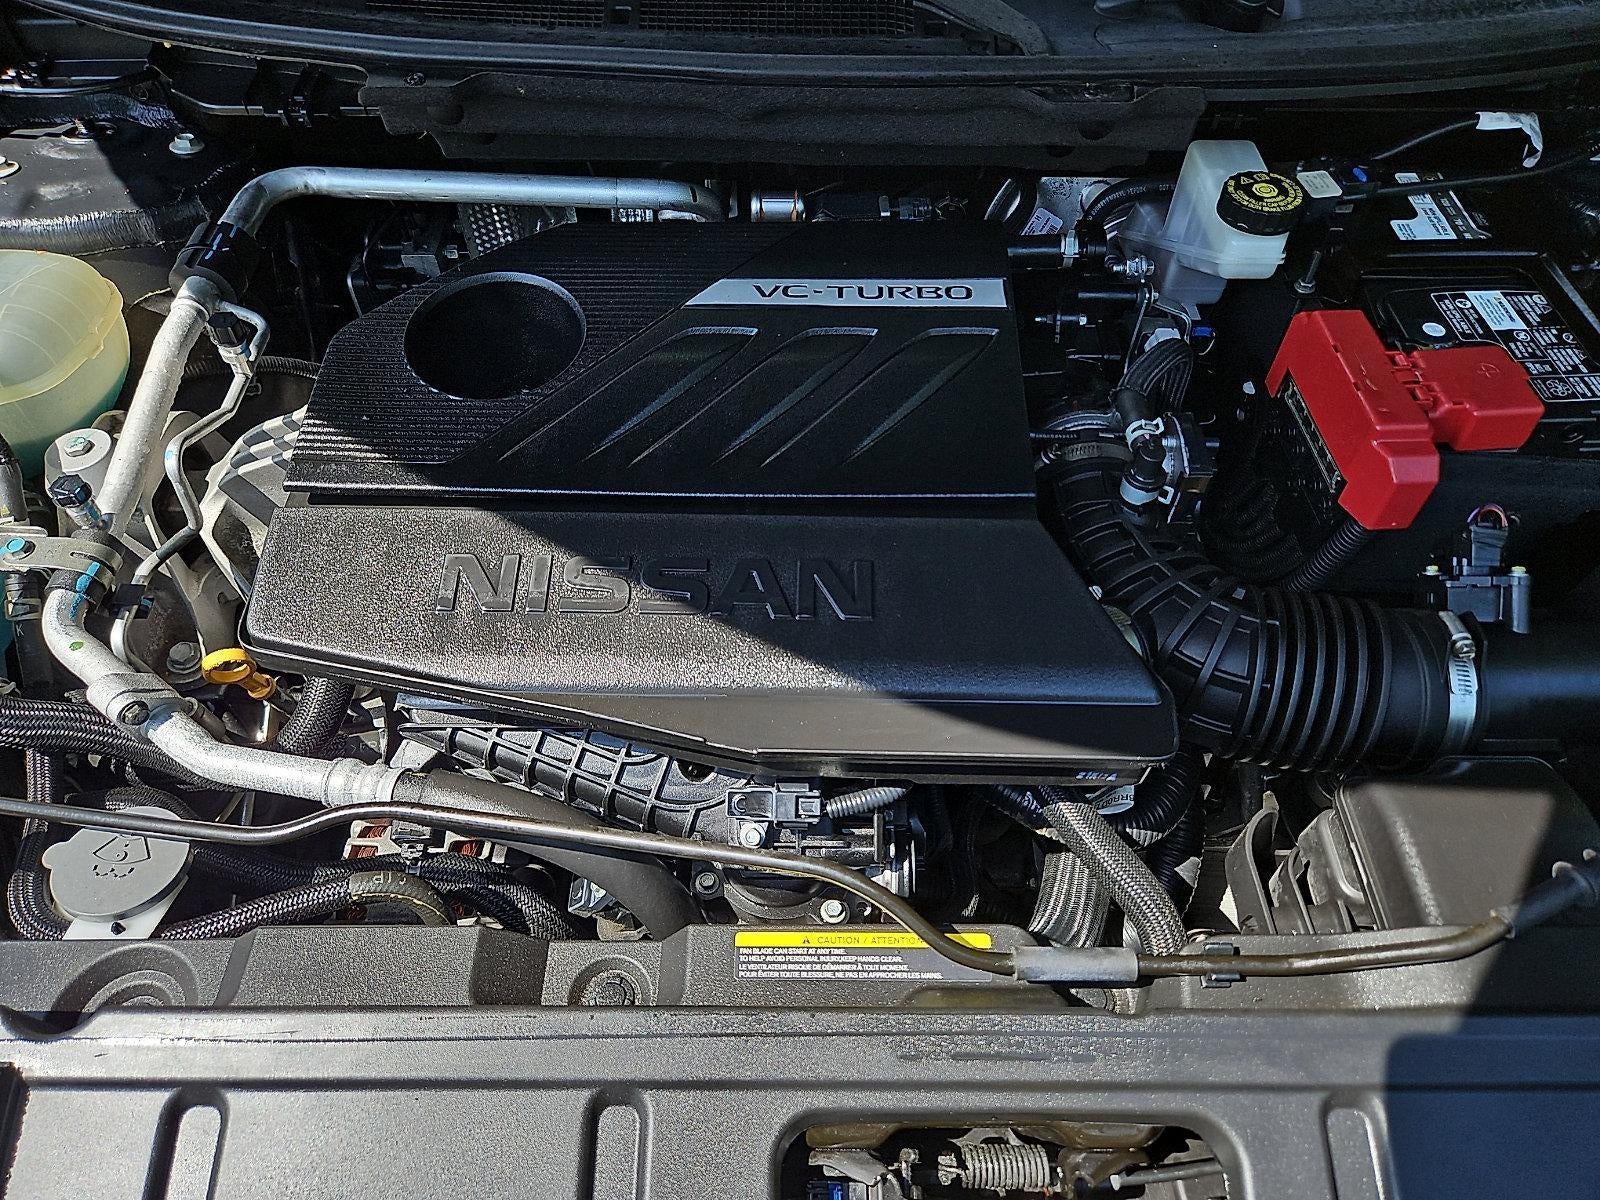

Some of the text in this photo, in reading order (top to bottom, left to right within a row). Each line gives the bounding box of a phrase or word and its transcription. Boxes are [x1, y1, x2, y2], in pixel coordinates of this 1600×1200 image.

[752, 284, 974, 300] VC-TURBO
[436, 553, 876, 623] NISSAN
[817, 936, 860, 944] CAUTION
